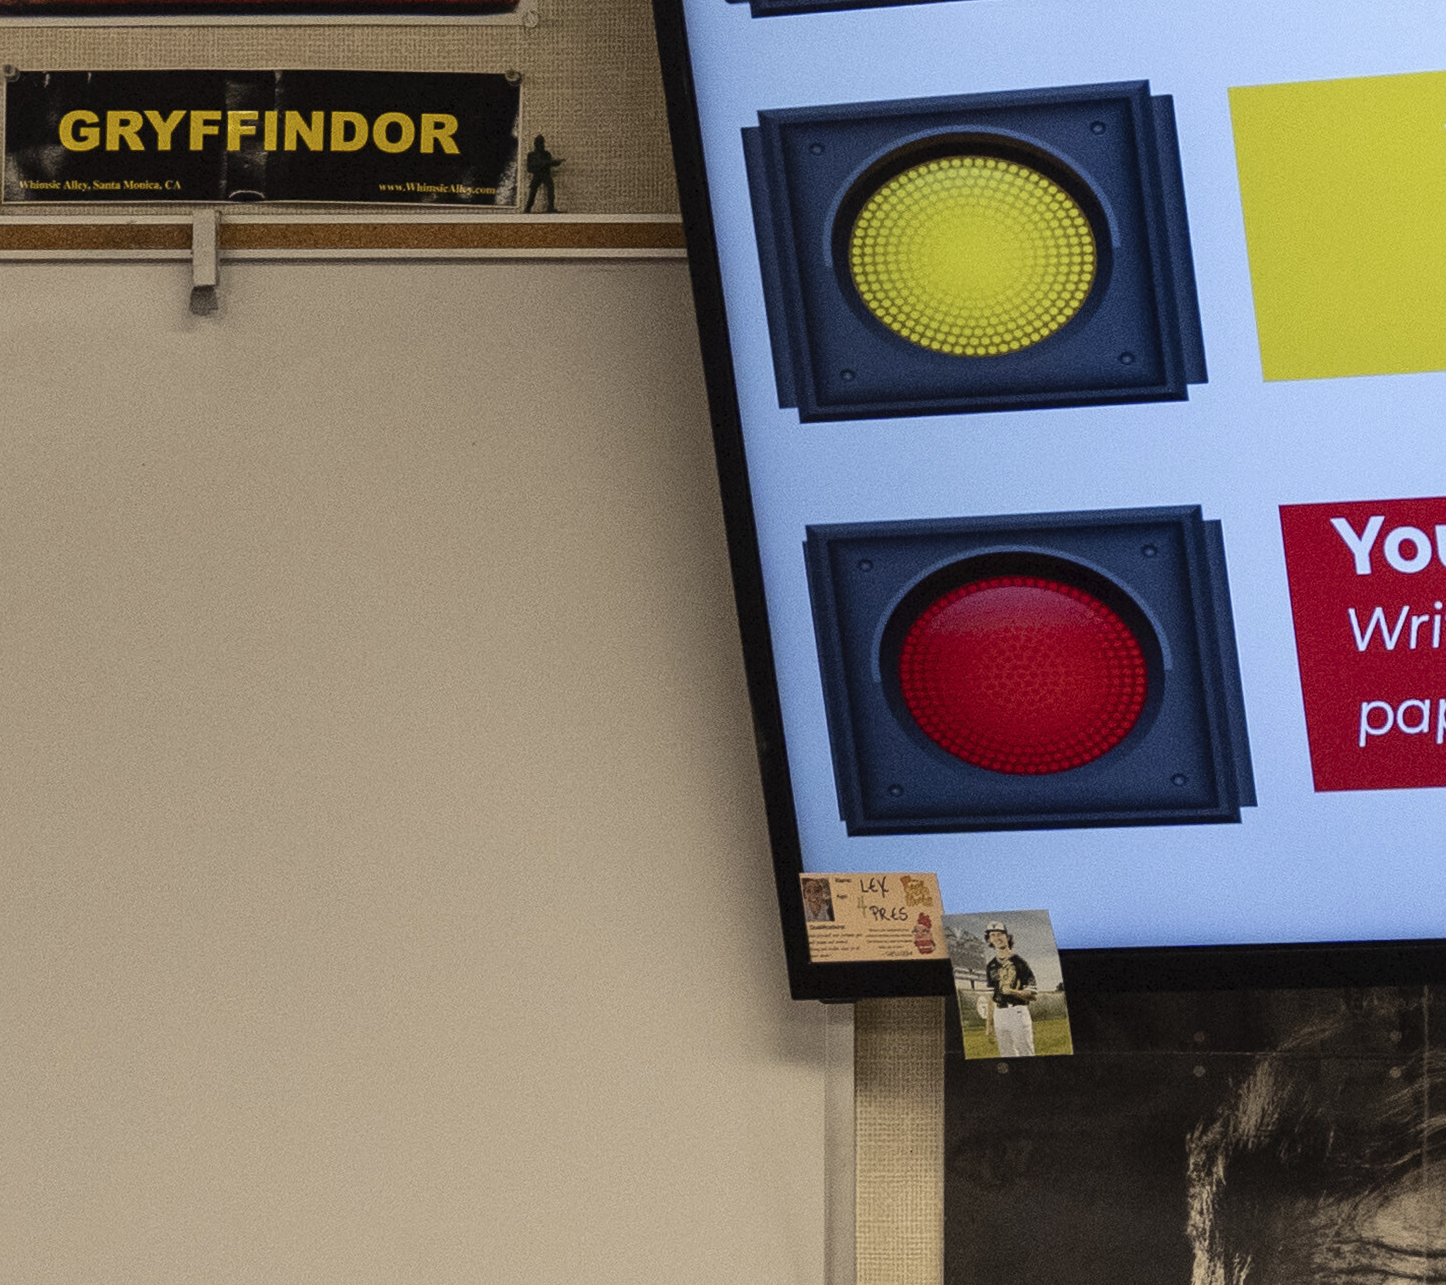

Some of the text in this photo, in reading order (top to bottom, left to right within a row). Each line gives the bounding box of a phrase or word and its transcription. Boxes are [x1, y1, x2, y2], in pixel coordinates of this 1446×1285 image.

[58, 110, 460, 154] GRYFFINDOR
[93, 180, 121, 190] Santa
[165, 180, 181, 190] CA
[868, 905, 909, 922] PRES
